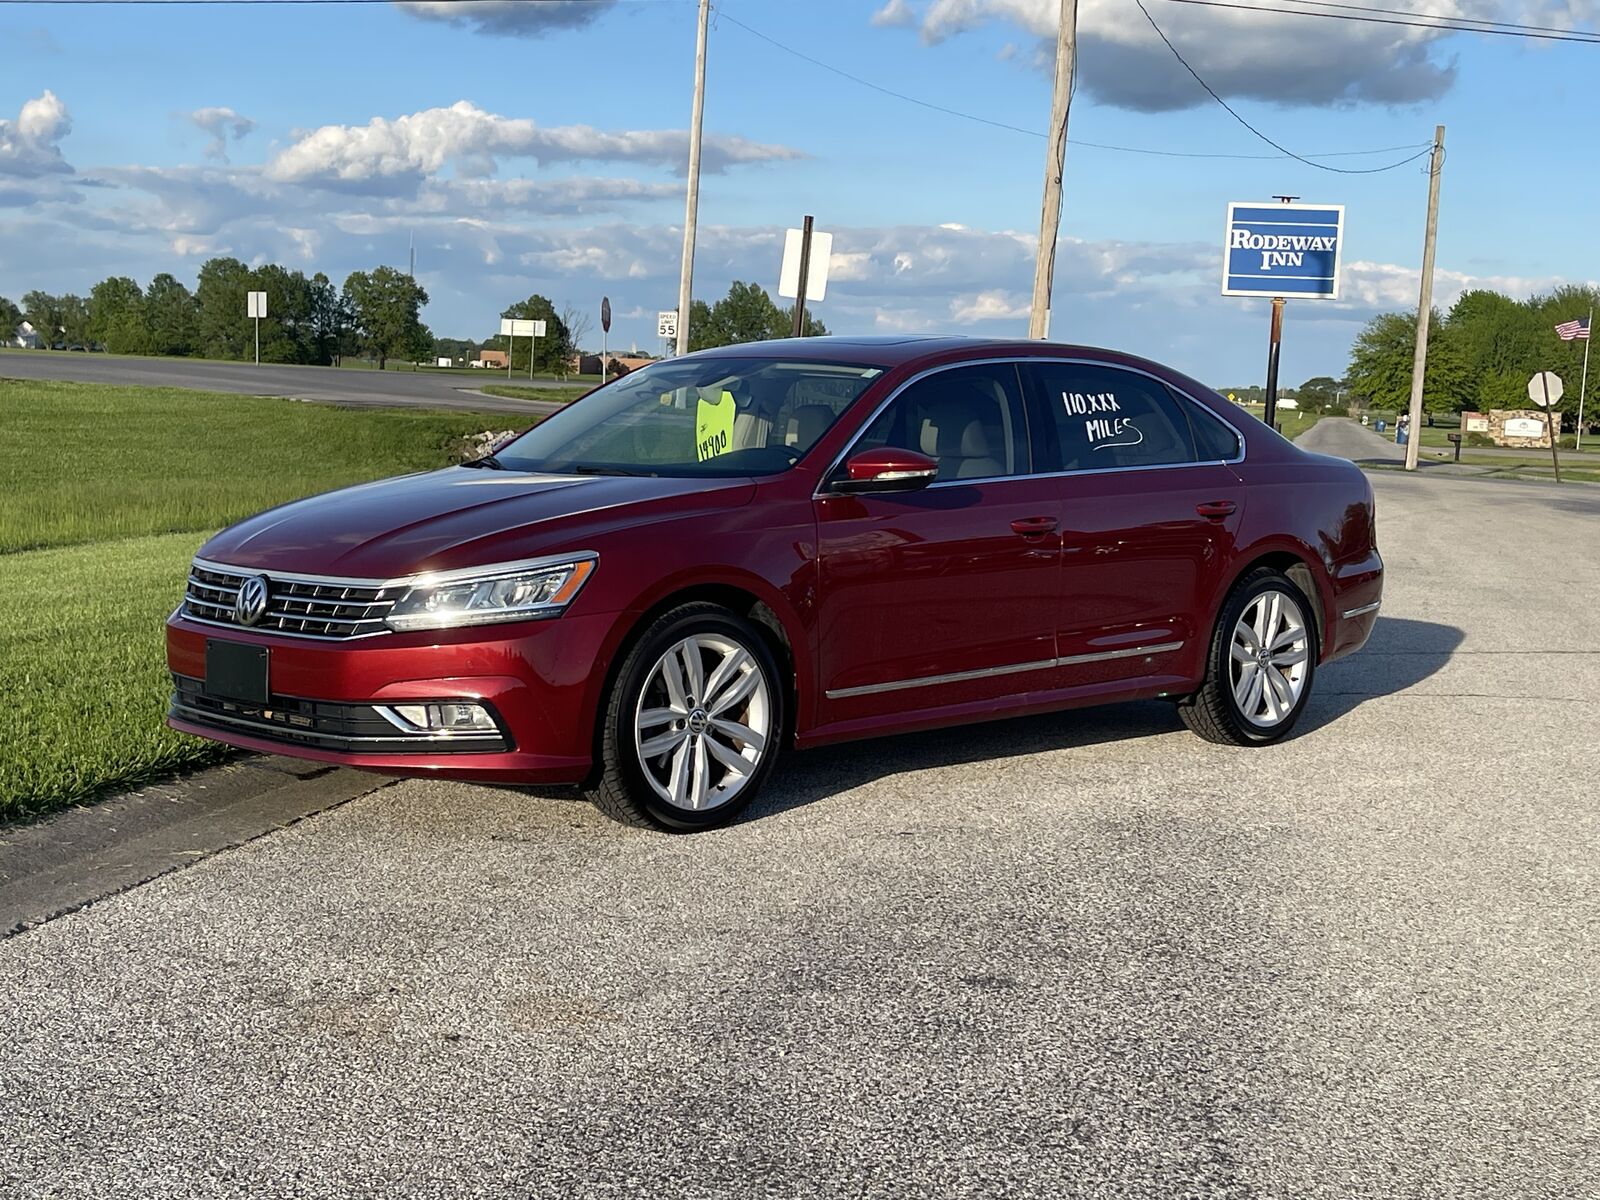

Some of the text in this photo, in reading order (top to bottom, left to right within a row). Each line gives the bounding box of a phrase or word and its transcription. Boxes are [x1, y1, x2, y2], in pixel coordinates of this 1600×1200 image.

[1231, 229, 1337, 251] RODEWAY
[1260, 251, 1304, 270] INN
[660, 325, 675, 335] 55
[1085, 418, 1143, 451] MILES
